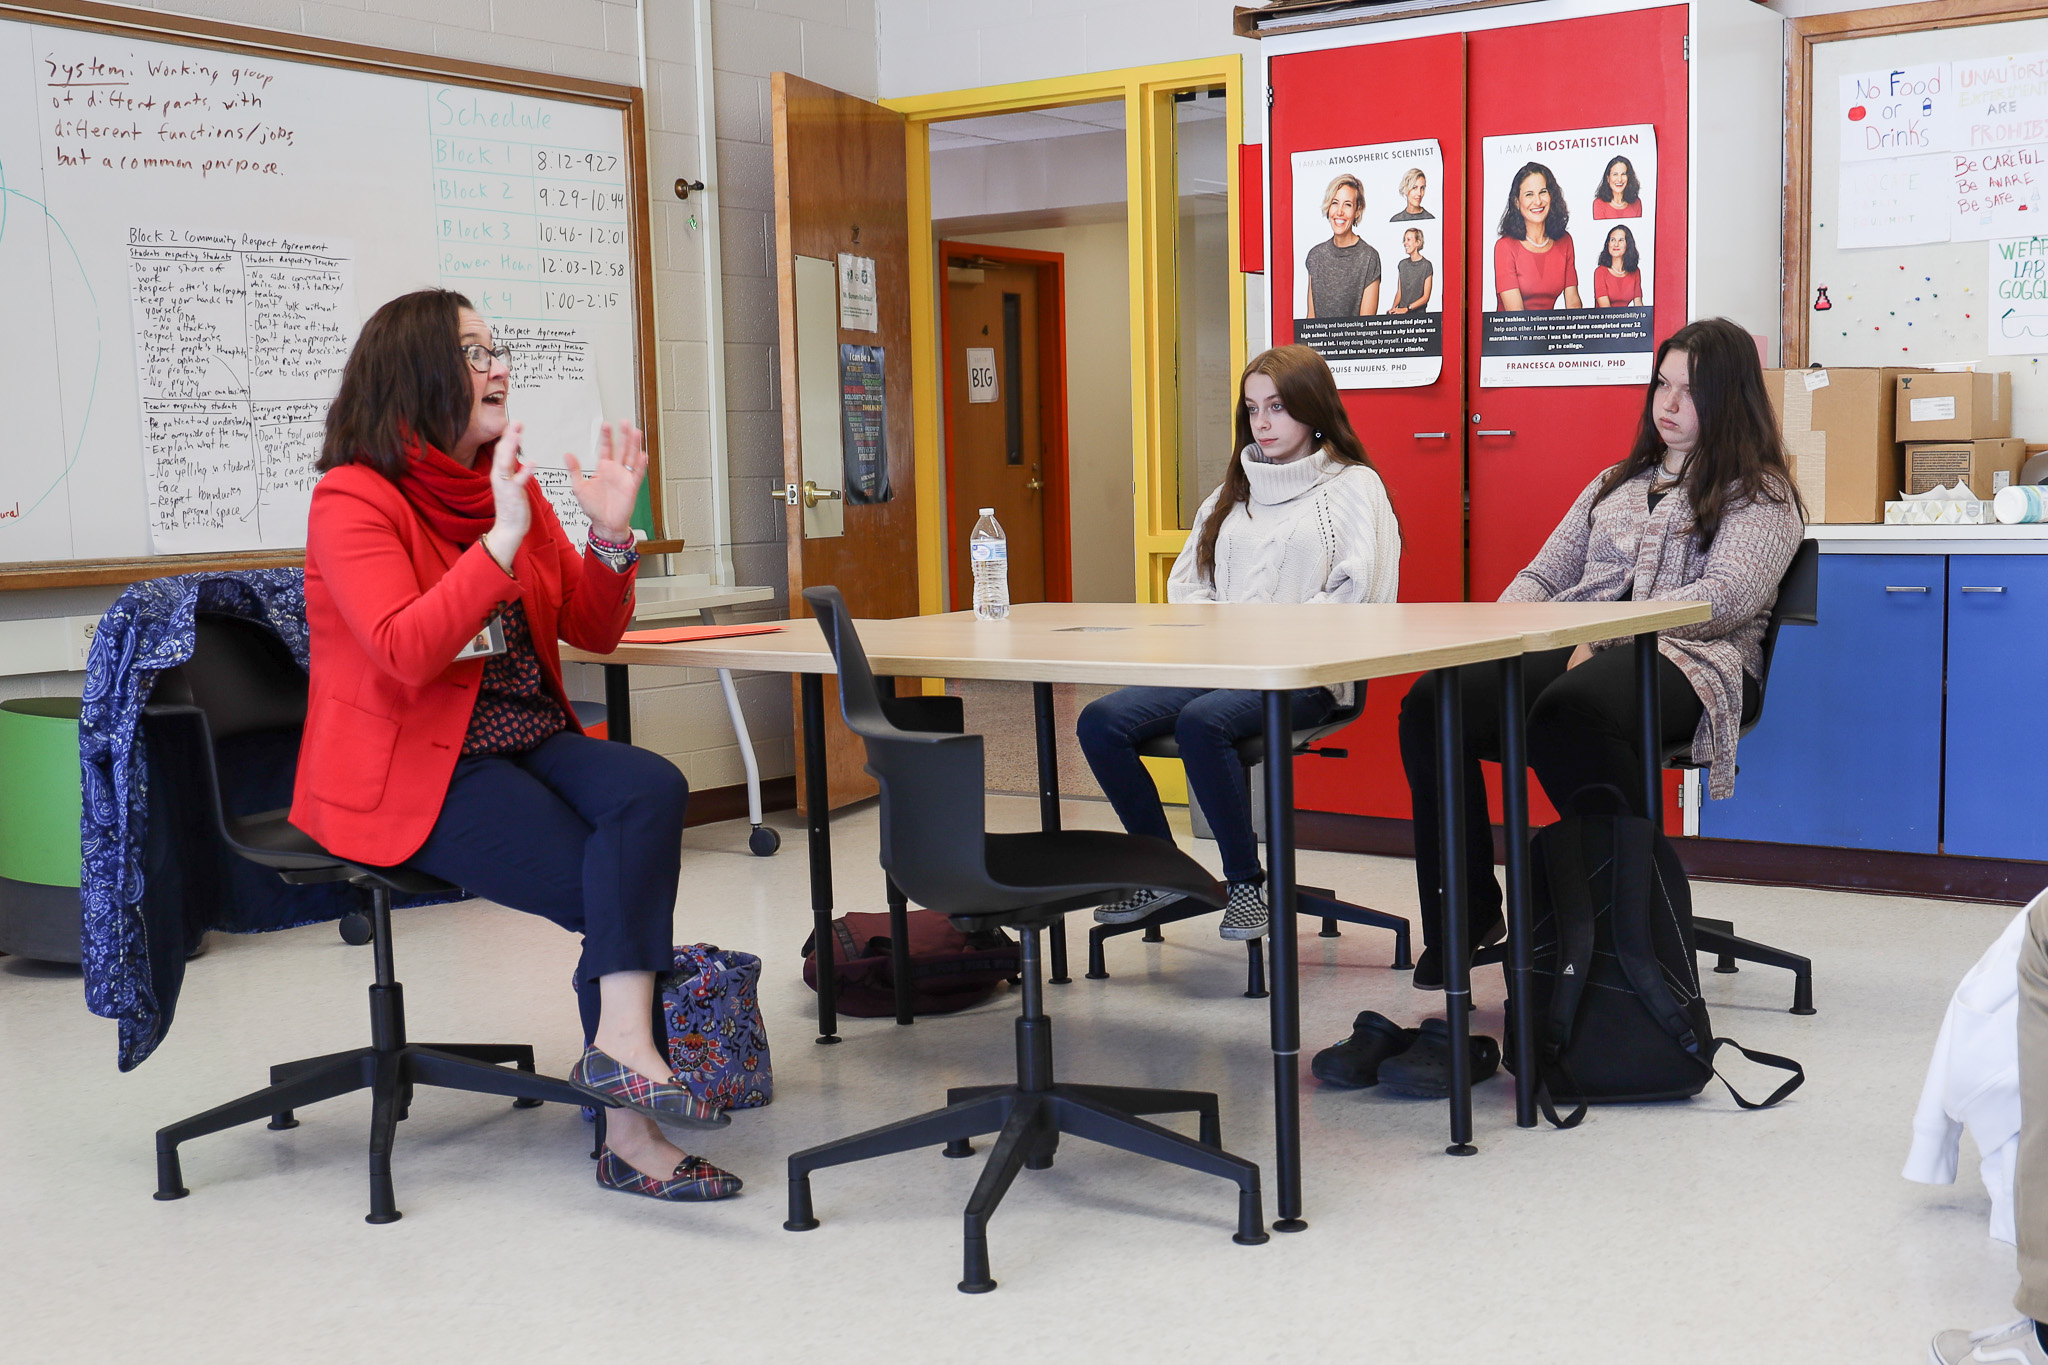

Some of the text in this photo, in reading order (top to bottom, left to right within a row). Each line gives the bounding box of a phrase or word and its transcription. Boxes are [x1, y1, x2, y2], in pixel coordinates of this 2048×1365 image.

[44, 53, 275, 89] System: Working group
[1960, 59, 2048, 88] UNAUTORI
[1856, 66, 1941, 99] No Food
[162, 92, 211, 117] parts,
[222, 92, 263, 110] with
[436, 88, 551, 130] Schedule
[1882, 103, 1902, 119] or
[1987, 100, 2017, 116] ARE
[1505, 144, 1523, 154] AM
[1536, 134, 1639, 152] BIOSTATISTICIAN
[1866, 119, 1929, 150] Drinks
[57, 146, 92, 167] but
[102, 157, 113, 169] a
[121, 156, 193, 170] common
[436, 138, 494, 165] Block
[1329, 151, 1389, 166] ATMOSPHERIC
[1392, 147, 1435, 159] SCIENTIST
[1954, 149, 2045, 177] Be CAREFUL
[440, 179, 488, 199] Block
[502, 182, 513, 199] 2
[1956, 171, 2035, 194] Be AWARE
[1957, 199, 1980, 215] Be
[129, 227, 328, 253] Block 2 Community Respect Agreement
[443, 219, 494, 239] Block
[502, 222, 511, 240] 3
[444, 254, 625, 276] Power Hour 12:03-12:58
[2014, 259, 2046, 280] LAB
[139, 282, 175, 296] Respect
[502, 292, 512, 311] 4
[546, 292, 619, 310] 1:00-2:15
[504, 324, 576, 340] Respect Agreement
[1506, 360, 1556, 370] FRANCESCA
[1607, 359, 1626, 367] PHD
[971, 367, 993, 388] BIG
